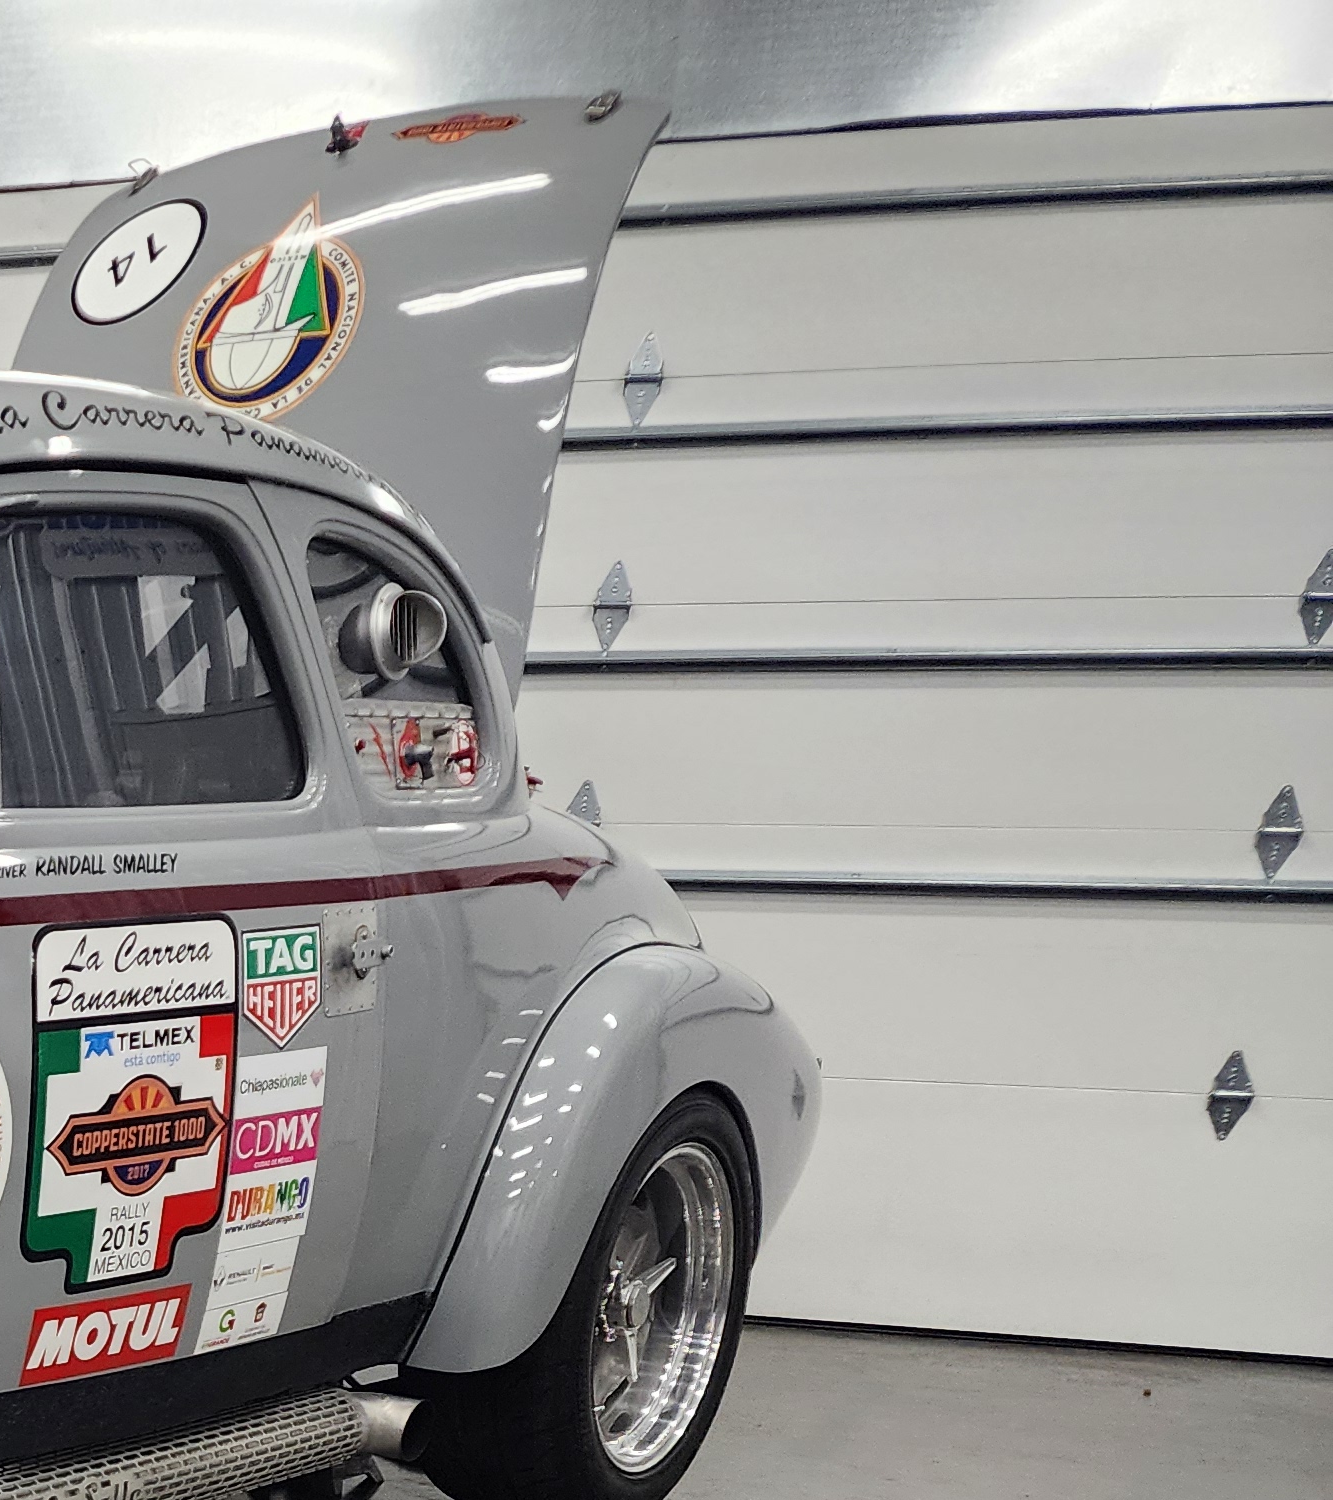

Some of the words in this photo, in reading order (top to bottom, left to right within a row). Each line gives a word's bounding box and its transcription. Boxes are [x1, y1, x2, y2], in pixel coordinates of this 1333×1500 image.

[107, 232, 168, 288] 14
[317, 291, 358, 370] NACIONAL
[271, 394, 288, 410] LA
[296, 376, 314, 396] DE
[41, 390, 205, 437] Carrera
[35, 854, 107, 877] RANDALL
[113, 852, 179, 875] SMALLEY
[62, 934, 104, 974] La
[114, 931, 213, 973] Carrera
[249, 935, 315, 976] TAG
[48, 976, 227, 1018] Panamericana
[248, 979, 317, 1035] HEUER
[116, 1025, 196, 1051] TELMEX
[124, 1053, 144, 1067] está
[146, 1051, 181, 1067] contigo
[73, 1122, 171, 1156] COPPERSTATE
[173, 1116, 206, 1141] 1000
[235, 1112, 319, 1160] CDMX
[126, 1163, 150, 1180] 2017
[109, 1201, 150, 1223] RALLY
[226, 1176, 310, 1223] DURANGO
[100, 1221, 151, 1252] 2015
[93, 1250, 152, 1276] MÉXICO
[26, 1298, 182, 1370] MOTUL
